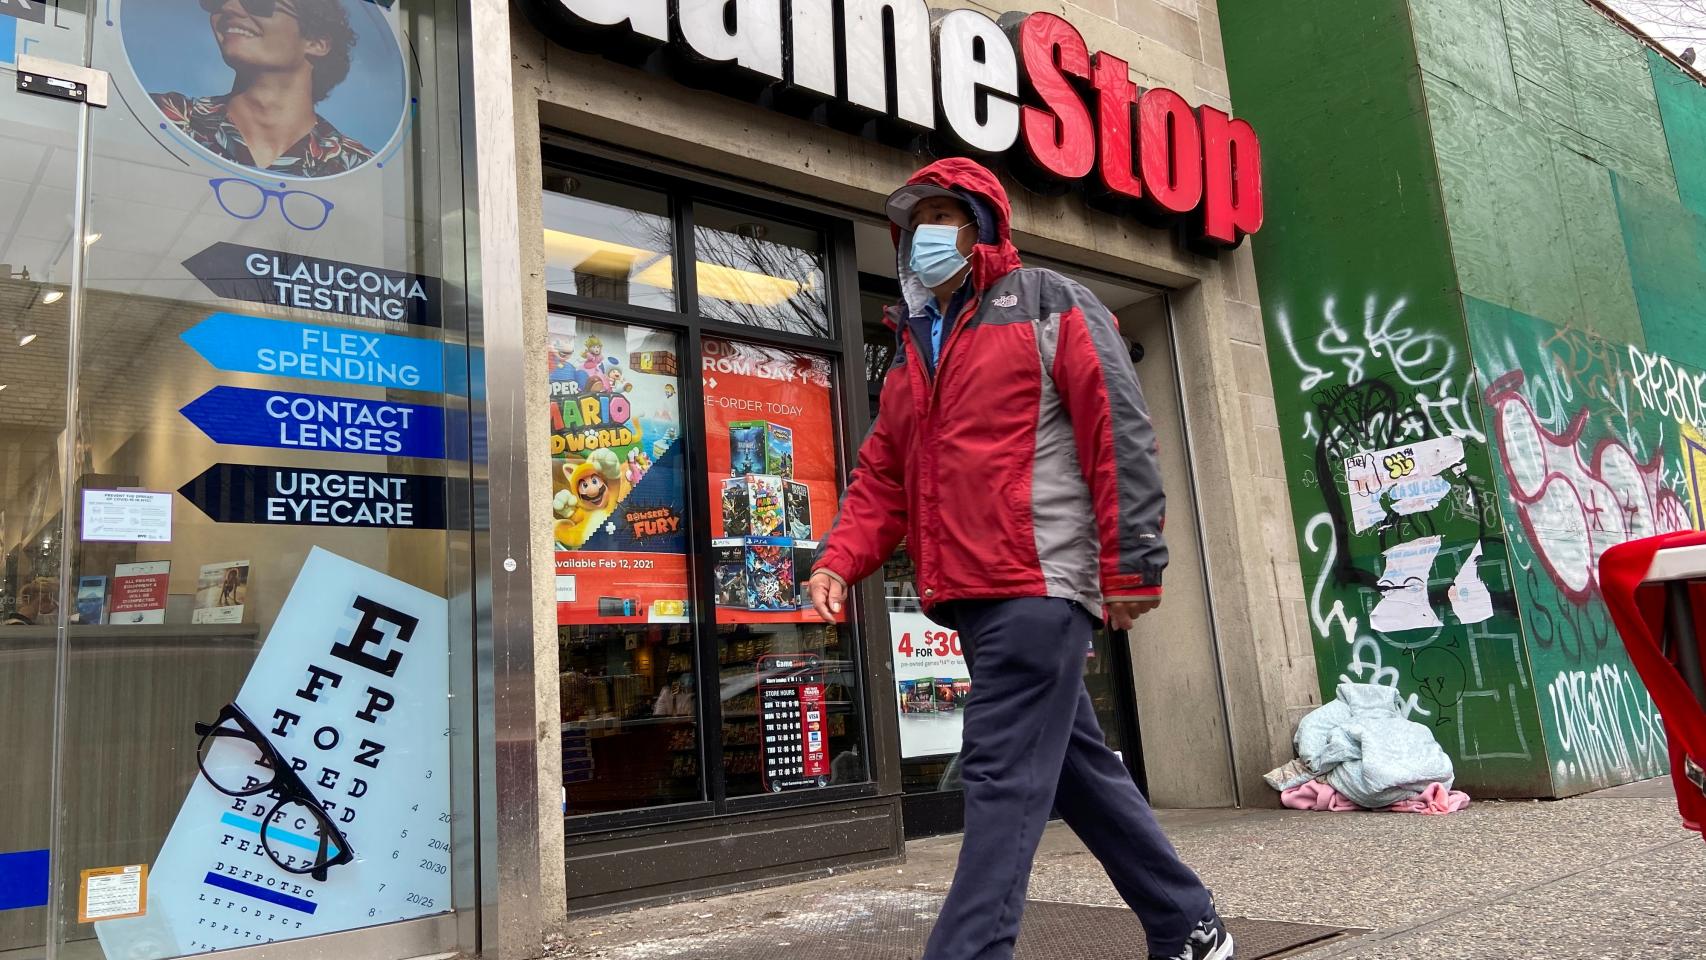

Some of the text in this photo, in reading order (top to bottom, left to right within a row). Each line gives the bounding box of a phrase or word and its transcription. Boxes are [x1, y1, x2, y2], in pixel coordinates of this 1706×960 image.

[246, 253, 428, 301] GLAUCOMA
[273, 281, 405, 320] TESTING
[302, 328, 380, 358] FLEX
[257, 348, 420, 386] SPENDING
[703, 357, 750, 376] ROM
[550, 381, 579, 396] PER
[266, 395, 413, 429] CONTACT
[704, 395, 803, 417] E-ORDER TODAY
[280, 422, 402, 453] LENSES
[566, 427, 632, 452] WORLD
[276, 471, 407, 500] URGENT
[267, 497, 413, 525] EYECARE
[633, 516, 680, 538] FURY
[599, 559, 617, 568] Feb
[619, 559, 631, 570] 12,
[633, 560, 654, 568] 2021
[330, 595, 419, 677] E
[898, 633, 913, 658] 4
[916, 649, 933, 658] FOR
[419, 859, 447, 875] 20/30
[406, 892, 434, 908] 20/25
